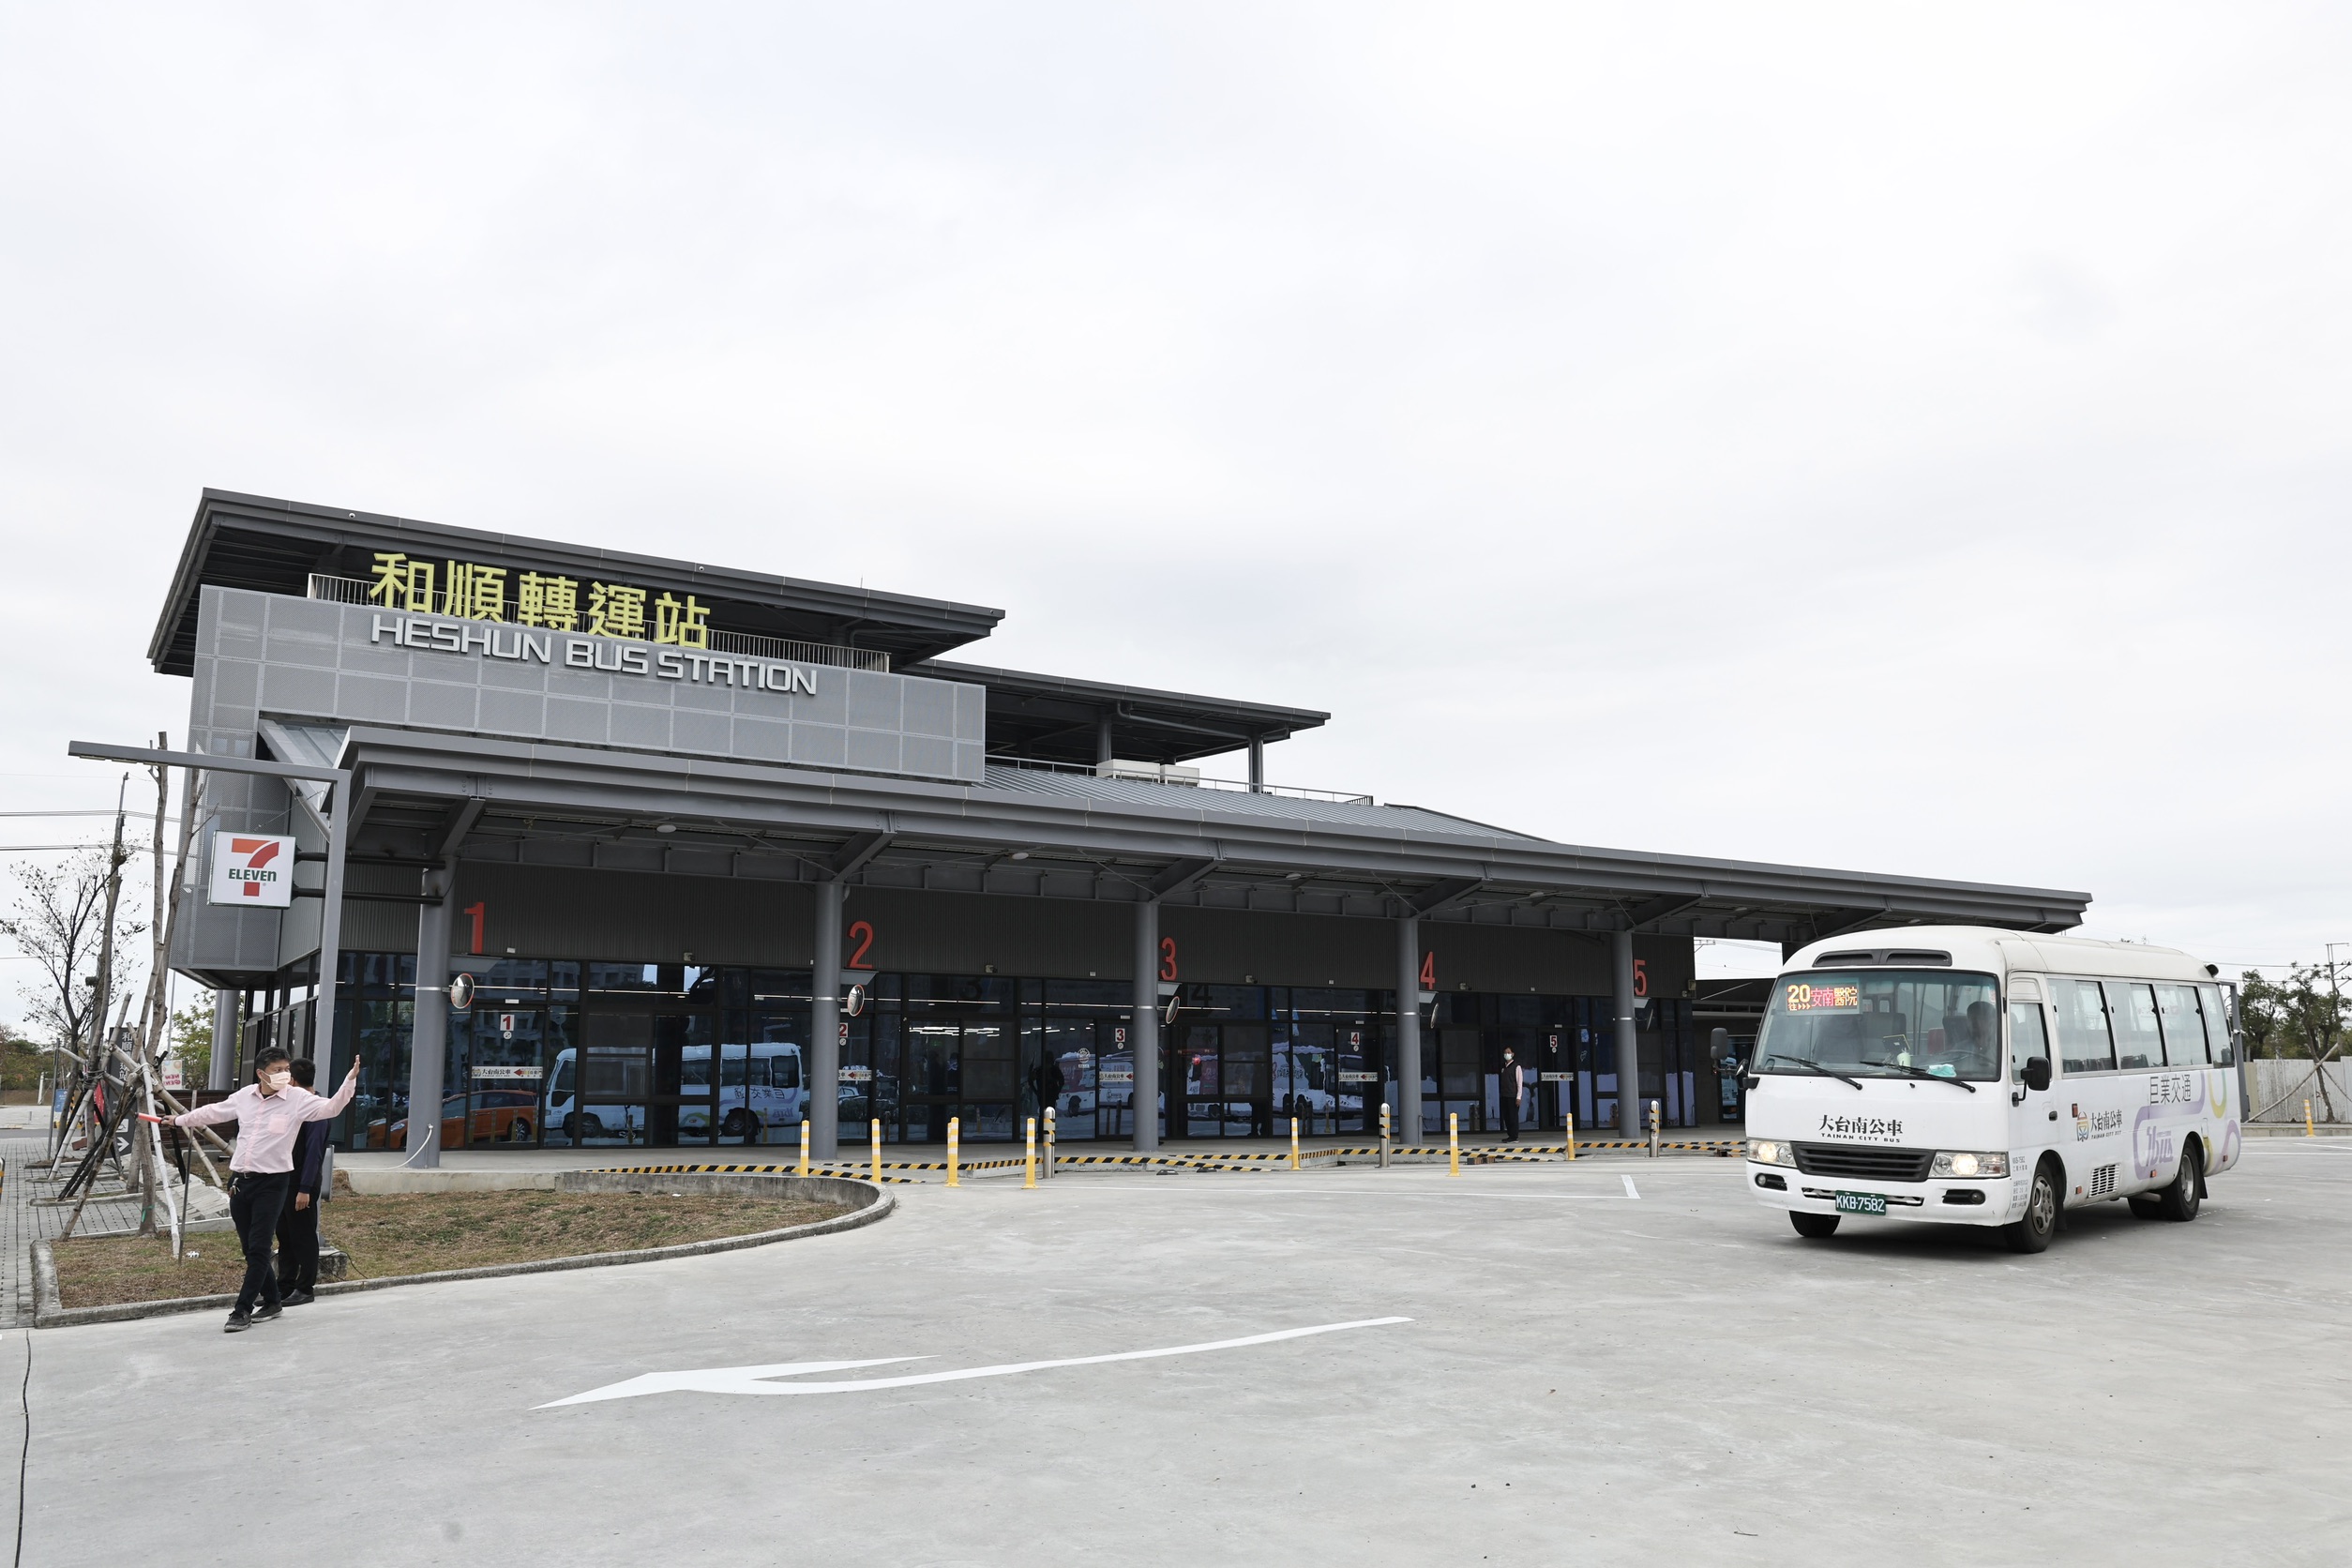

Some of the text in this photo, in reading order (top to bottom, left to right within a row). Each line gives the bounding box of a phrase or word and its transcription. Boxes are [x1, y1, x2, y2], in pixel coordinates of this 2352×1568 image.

[369, 552, 711, 649] 和順轉運站
[371, 614, 818, 695] HESHUN BUS STATION
[231, 837, 279, 897] 7
[464, 901, 485, 955] 1
[847, 920, 874, 969] 2
[1160, 937, 1177, 981] 3
[1420, 951, 1436, 990] 4
[1634, 958, 1647, 996] 5
[1787, 984, 1858, 1008] 20 安南醫院
[1788, 1003, 1798, 1012] 往
[503, 1015, 511, 1031] 1
[839, 1023, 848, 1037] 2
[1116, 1029, 1124, 1042] 3
[1351, 1033, 1359, 1045] 4
[1550, 1035, 1557, 1047] 5
[119, 1032, 133, 1081] 和順站
[2149, 1074, 2192, 1105] 巨業交通
[1819, 1114, 1904, 1137] 大台南公車
[2090, 1109, 2123, 1132] 大台南公車
[1821, 1132, 1854, 1140] TAINAN
[1835, 1194, 1885, 1213] KKB-7582
